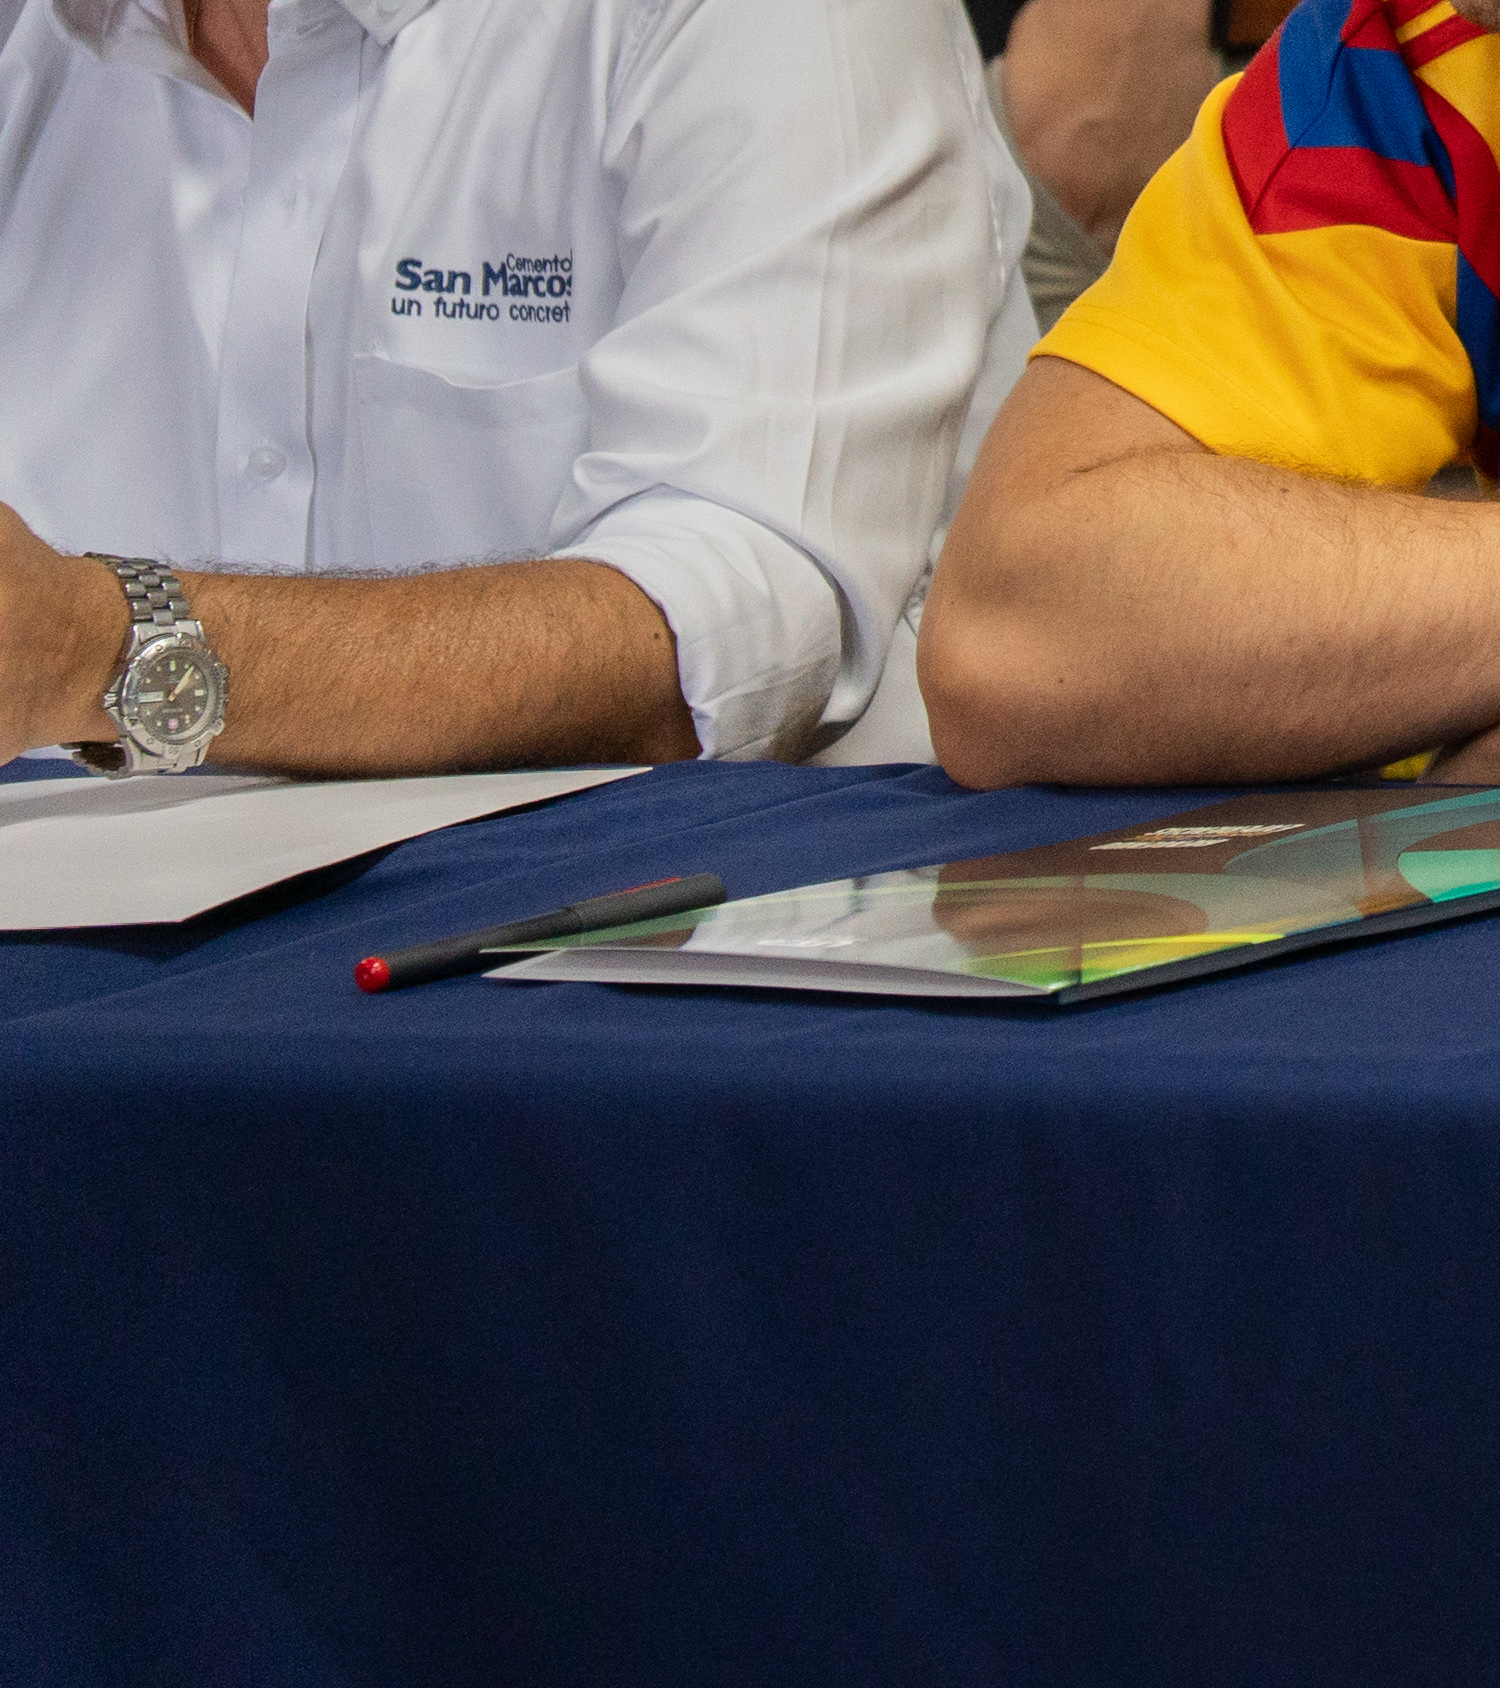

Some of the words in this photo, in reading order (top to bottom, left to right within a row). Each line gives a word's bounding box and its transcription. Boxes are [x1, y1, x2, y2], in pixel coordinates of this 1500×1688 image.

[395, 258, 471, 295] San
[391, 296, 422, 316] un
[434, 296, 500, 320] futuro
